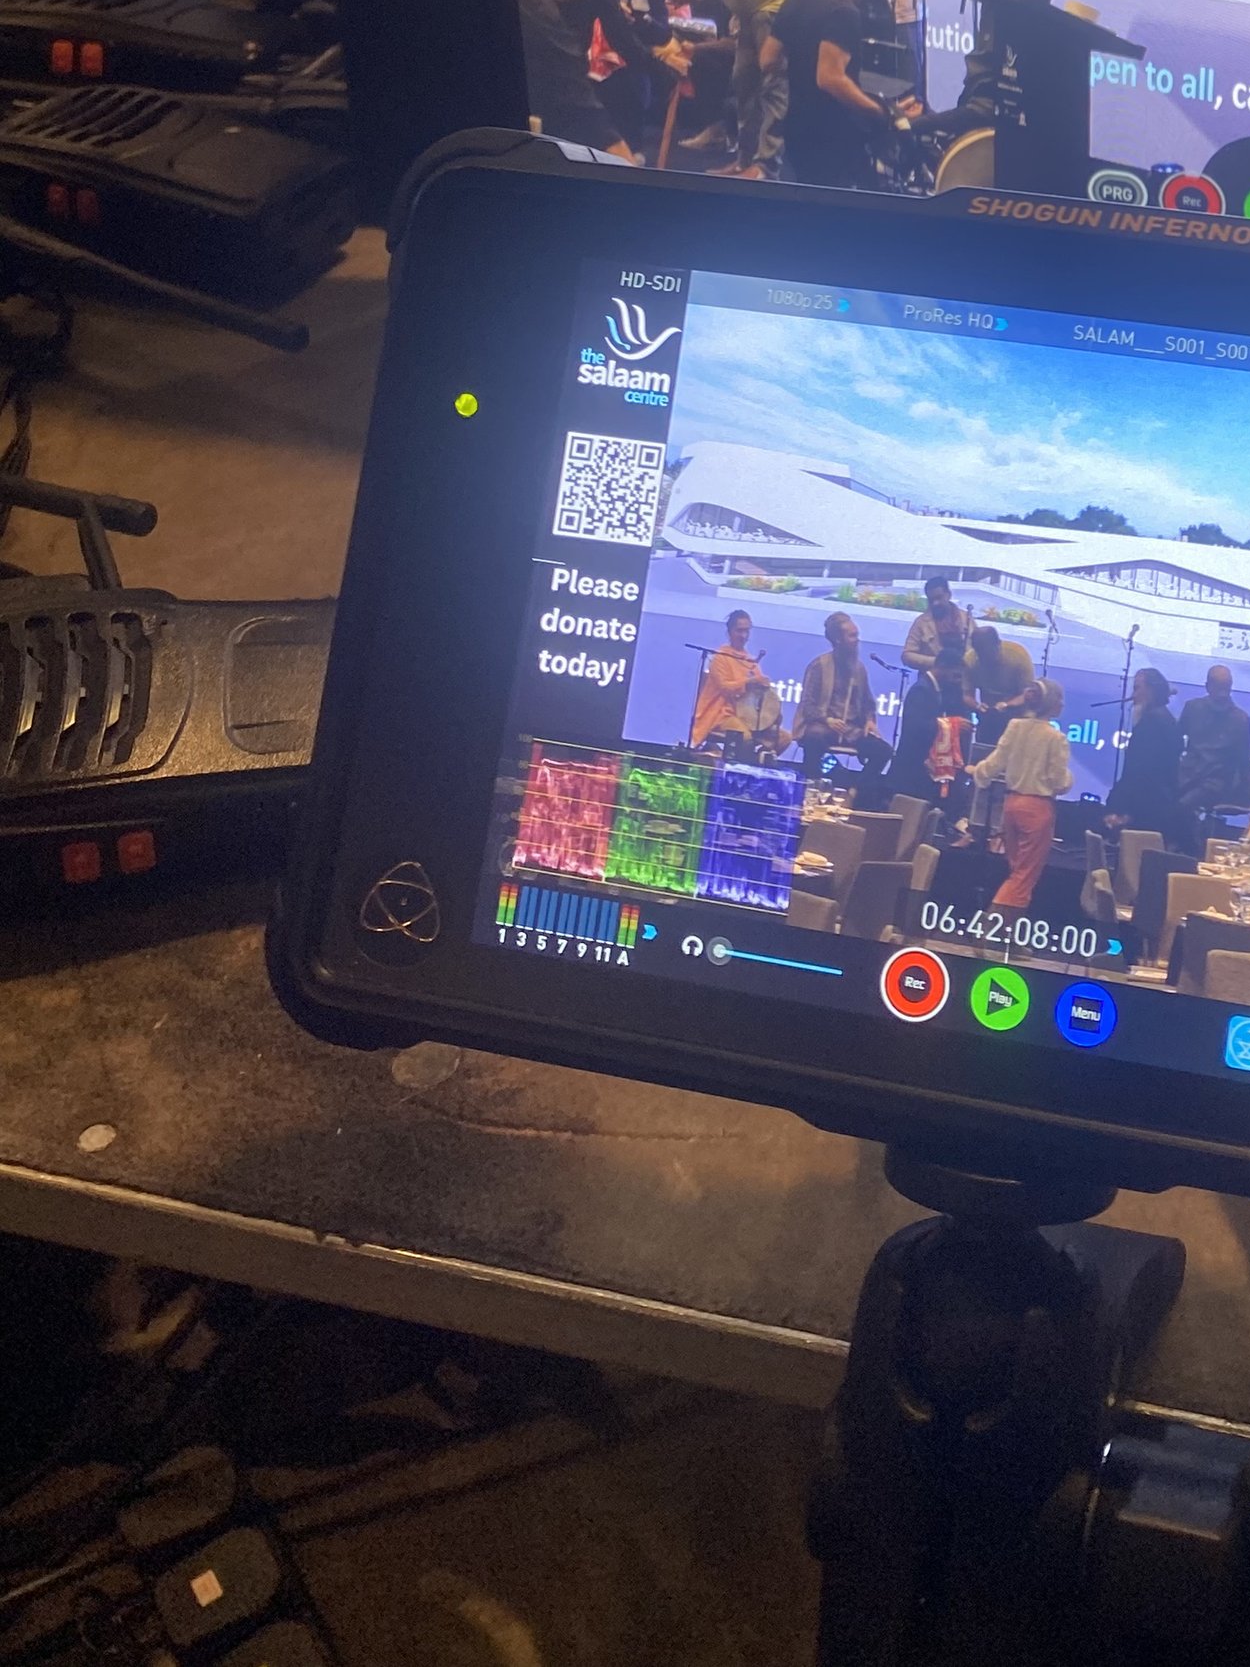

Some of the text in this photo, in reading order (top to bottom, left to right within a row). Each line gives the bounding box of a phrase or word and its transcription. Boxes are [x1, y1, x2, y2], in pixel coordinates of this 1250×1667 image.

[1090, 51, 1137, 88] pen
[1145, 60, 1174, 95] to
[1181, 66, 1224, 111] all,
[1101, 184, 1134, 202] PRG
[1181, 195, 1202, 208] Rec
[967, 195, 1103, 229] SHOGUN
[619, 270, 682, 293] HD-SDI
[903, 303, 994, 331] ProRes HQ
[580, 347, 606, 365] the
[577, 360, 671, 393] salaam
[624, 389, 670, 407] centre
[550, 568, 640, 602] Please
[539, 607, 637, 643] donate
[538, 648, 627, 687] today!
[920, 901, 1098, 958] 06:42:08:00
[498, 928, 631, 967] 1 3 5 7 9 11 A
[904, 975, 926, 991] Rec
[988, 990, 1013, 1008] Play
[1071, 1005, 1102, 1022] Menu
